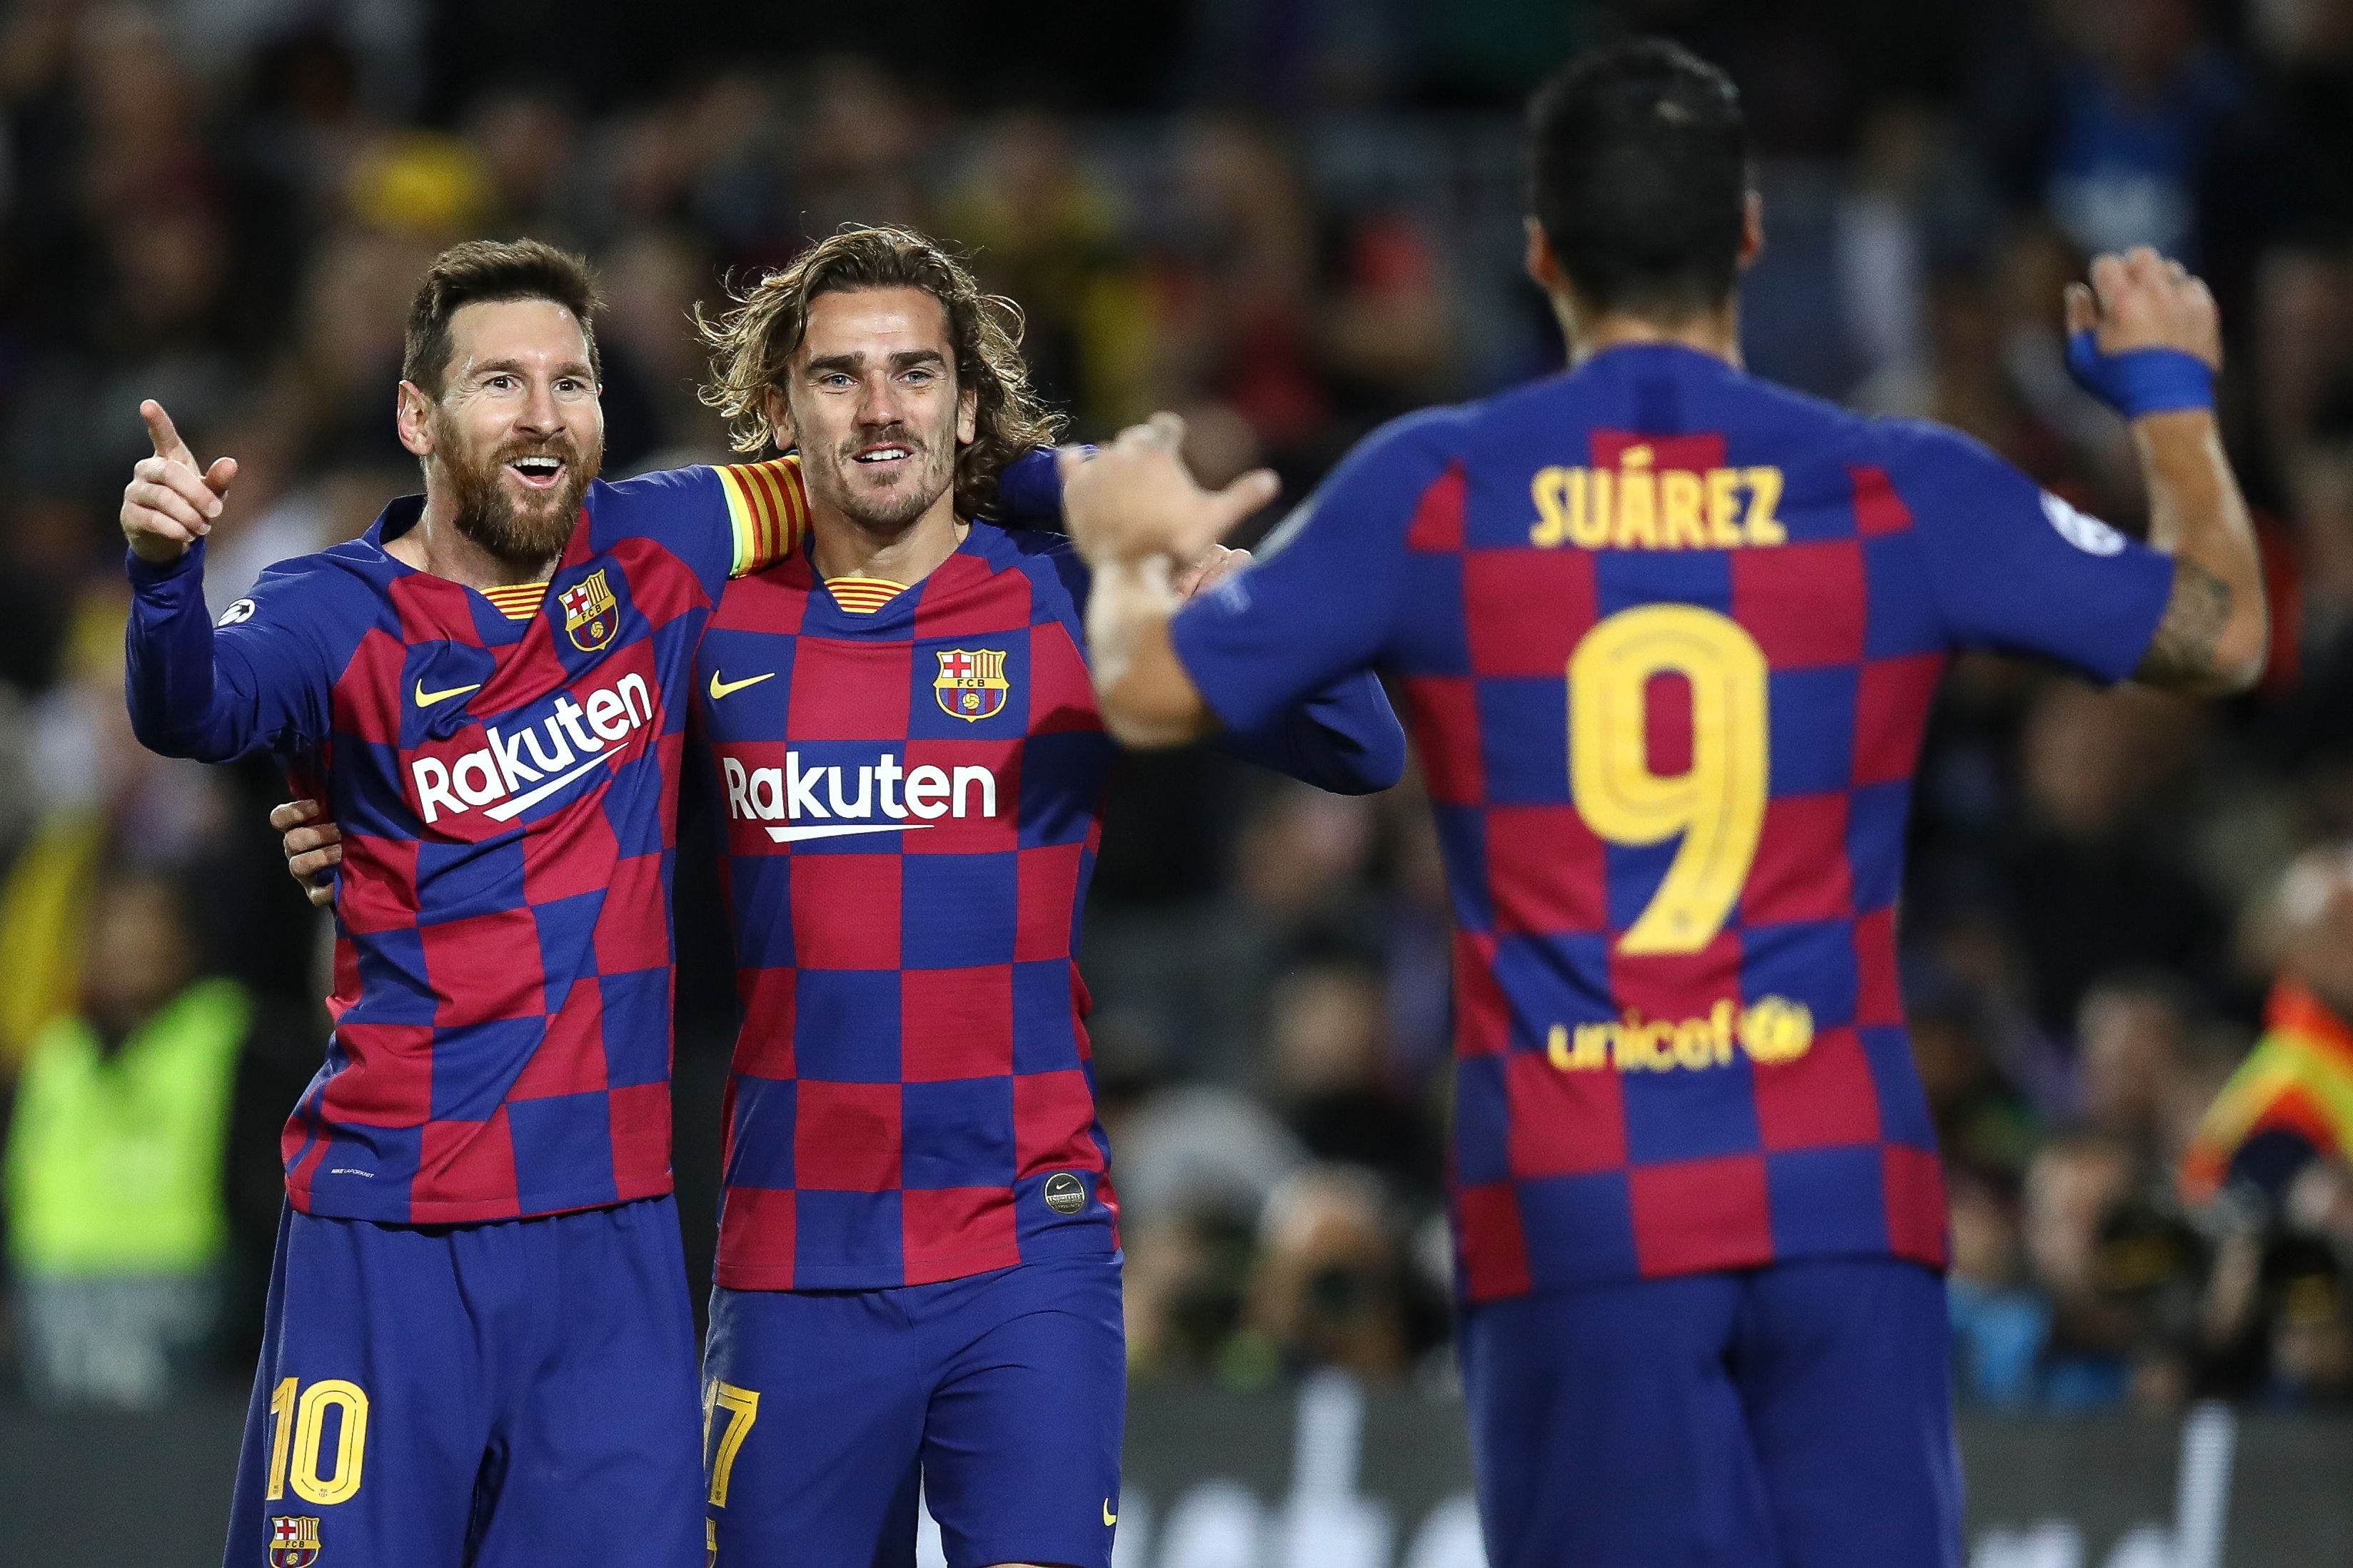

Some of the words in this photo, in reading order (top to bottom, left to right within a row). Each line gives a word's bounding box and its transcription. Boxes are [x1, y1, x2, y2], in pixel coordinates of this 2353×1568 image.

[1530, 444, 1786, 549] SUÁREZ
[581, 605, 602, 622] FCB
[957, 679, 985, 687] FCB
[412, 672, 652, 823] Rakuten
[723, 752, 996, 819] Rakuten
[1567, 601, 1769, 954] 9
[266, 1377, 369, 1504] 10
